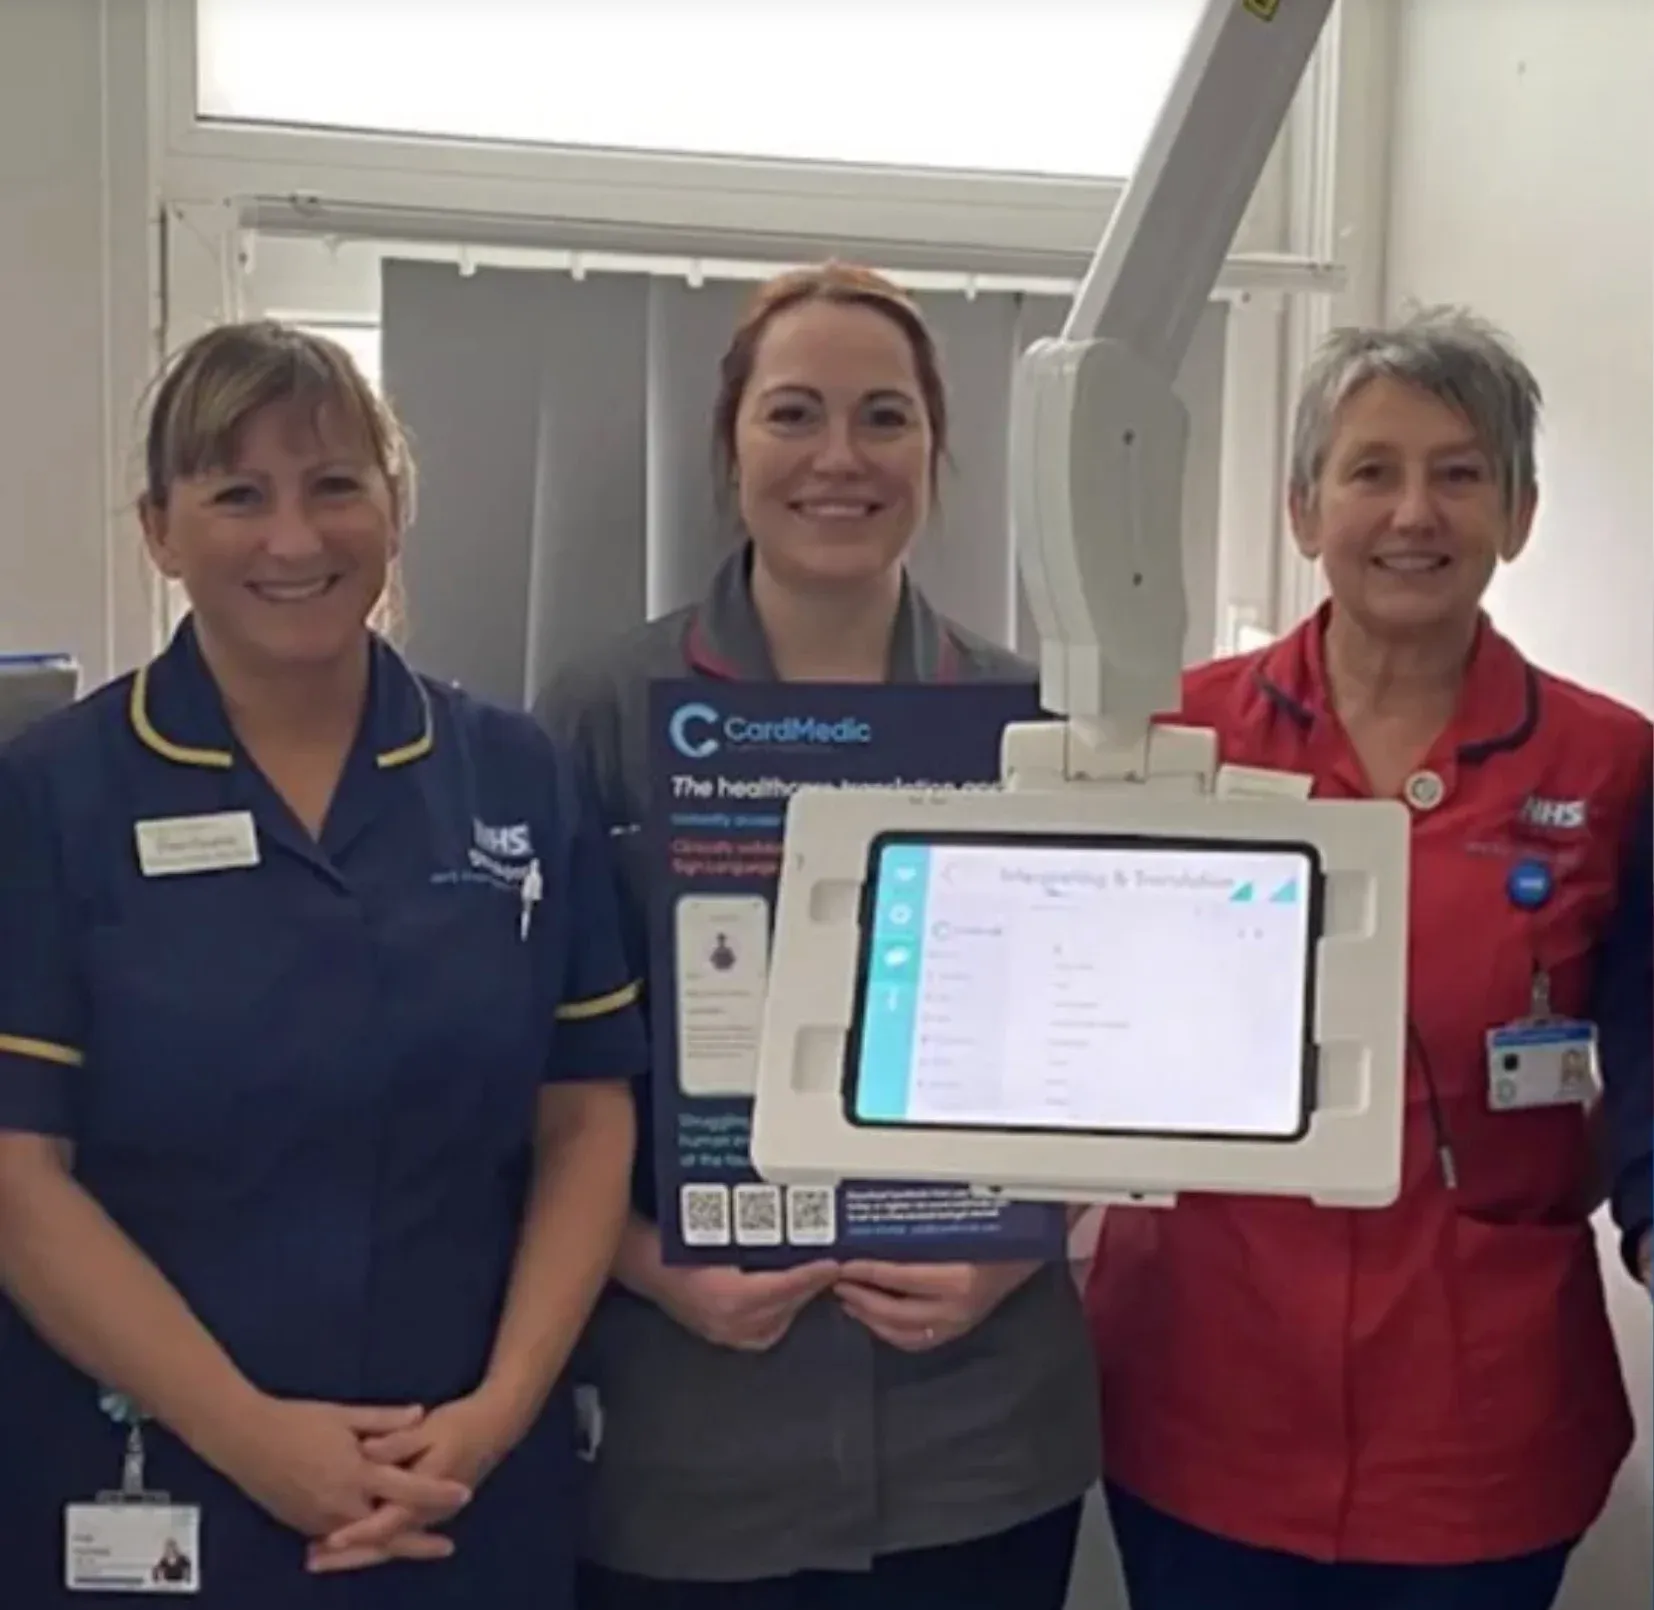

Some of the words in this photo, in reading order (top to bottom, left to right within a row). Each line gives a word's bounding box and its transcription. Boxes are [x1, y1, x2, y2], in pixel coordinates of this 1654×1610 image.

[723, 717, 871, 742] CardMedic
[670, 775, 713, 798] The
[1520, 795, 1586, 828] NHS
[472, 818, 531, 856] NHS
